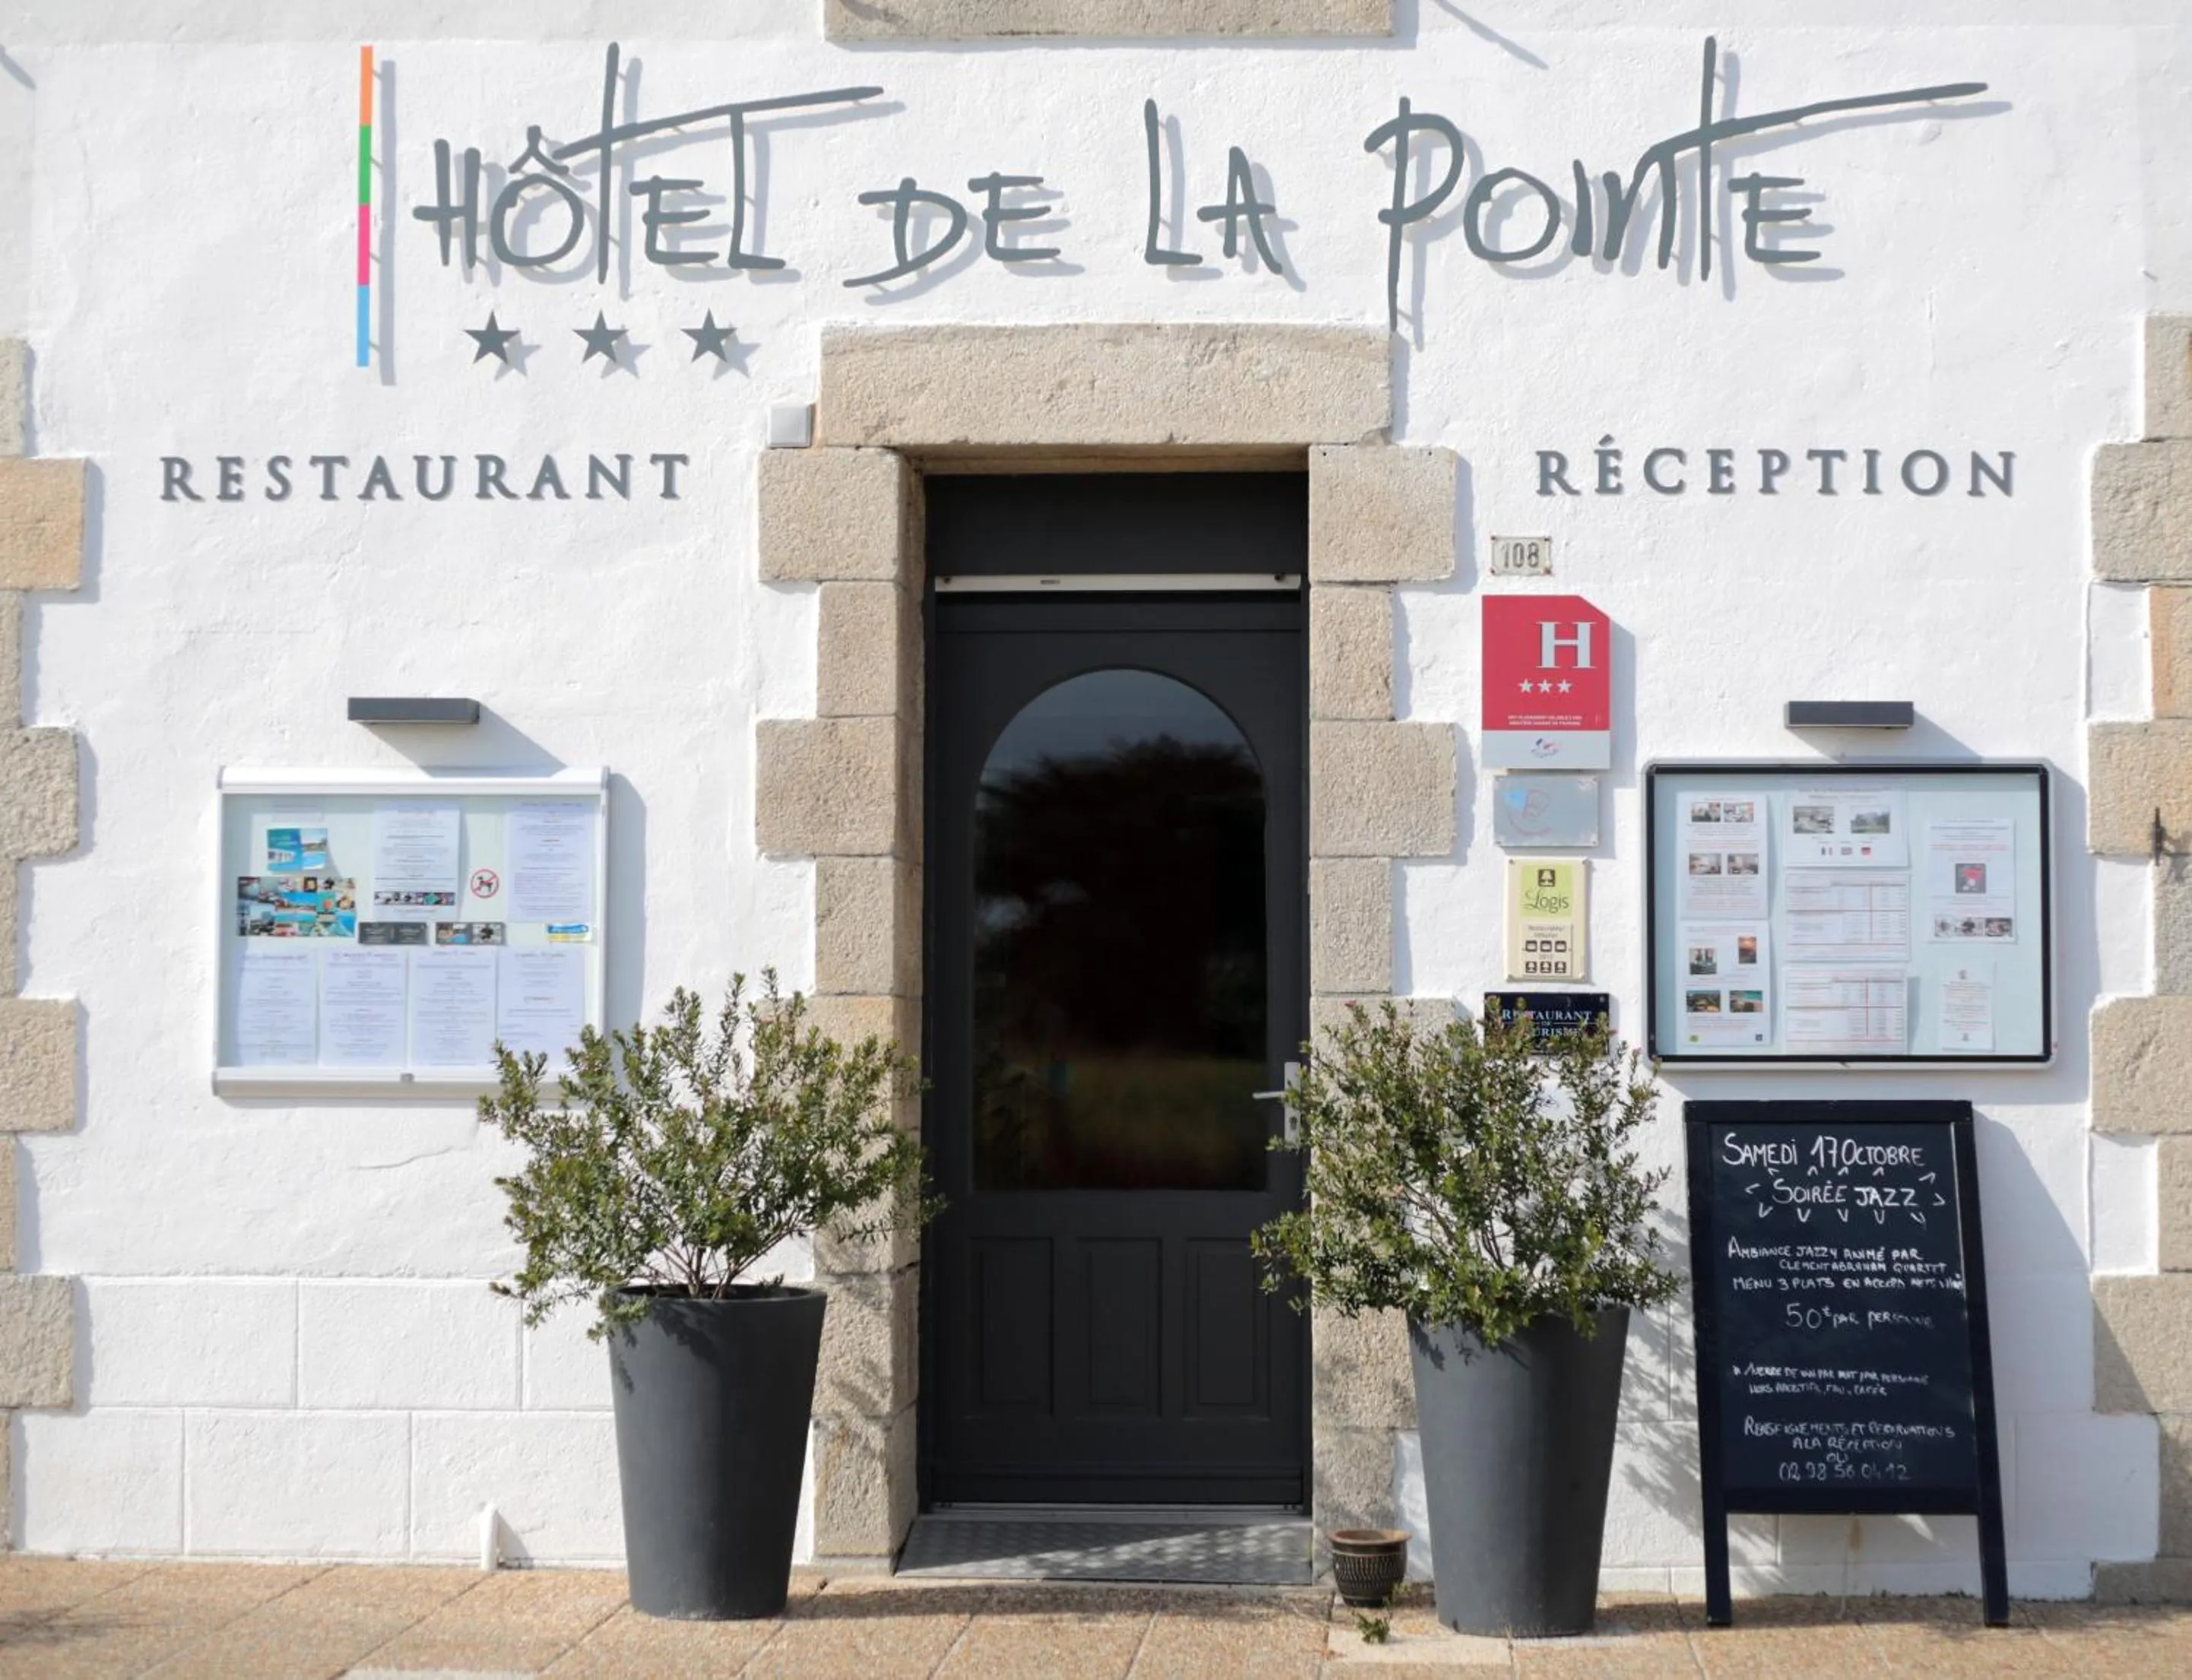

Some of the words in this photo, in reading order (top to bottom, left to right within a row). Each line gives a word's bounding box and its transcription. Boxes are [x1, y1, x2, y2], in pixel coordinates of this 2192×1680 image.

[843, 172, 1061, 287] DE
[1144, 98, 1283, 274] LA
[160, 454, 689, 502] RESTAURANT
[1536, 434, 2016, 497] RÉCEPTION
[1501, 541, 1540, 569] 108
[1535, 621, 1597, 669] H
[1522, 888, 1569, 914] Logis
[1722, 1132, 1797, 1167] SAMEDI
[1810, 1135, 1838, 1168] 17
[1841, 1138, 1925, 1167] OCTOBRE
[1853, 1187, 1919, 1207] JAZZ
[1892, 1247, 1924, 1261] PAR
[1733, 1276, 1772, 1290] MENU
[1777, 1277, 1789, 1290] 3
[1791, 1277, 1835, 1289] PLATS
[1842, 1278, 1861, 1289] EN
